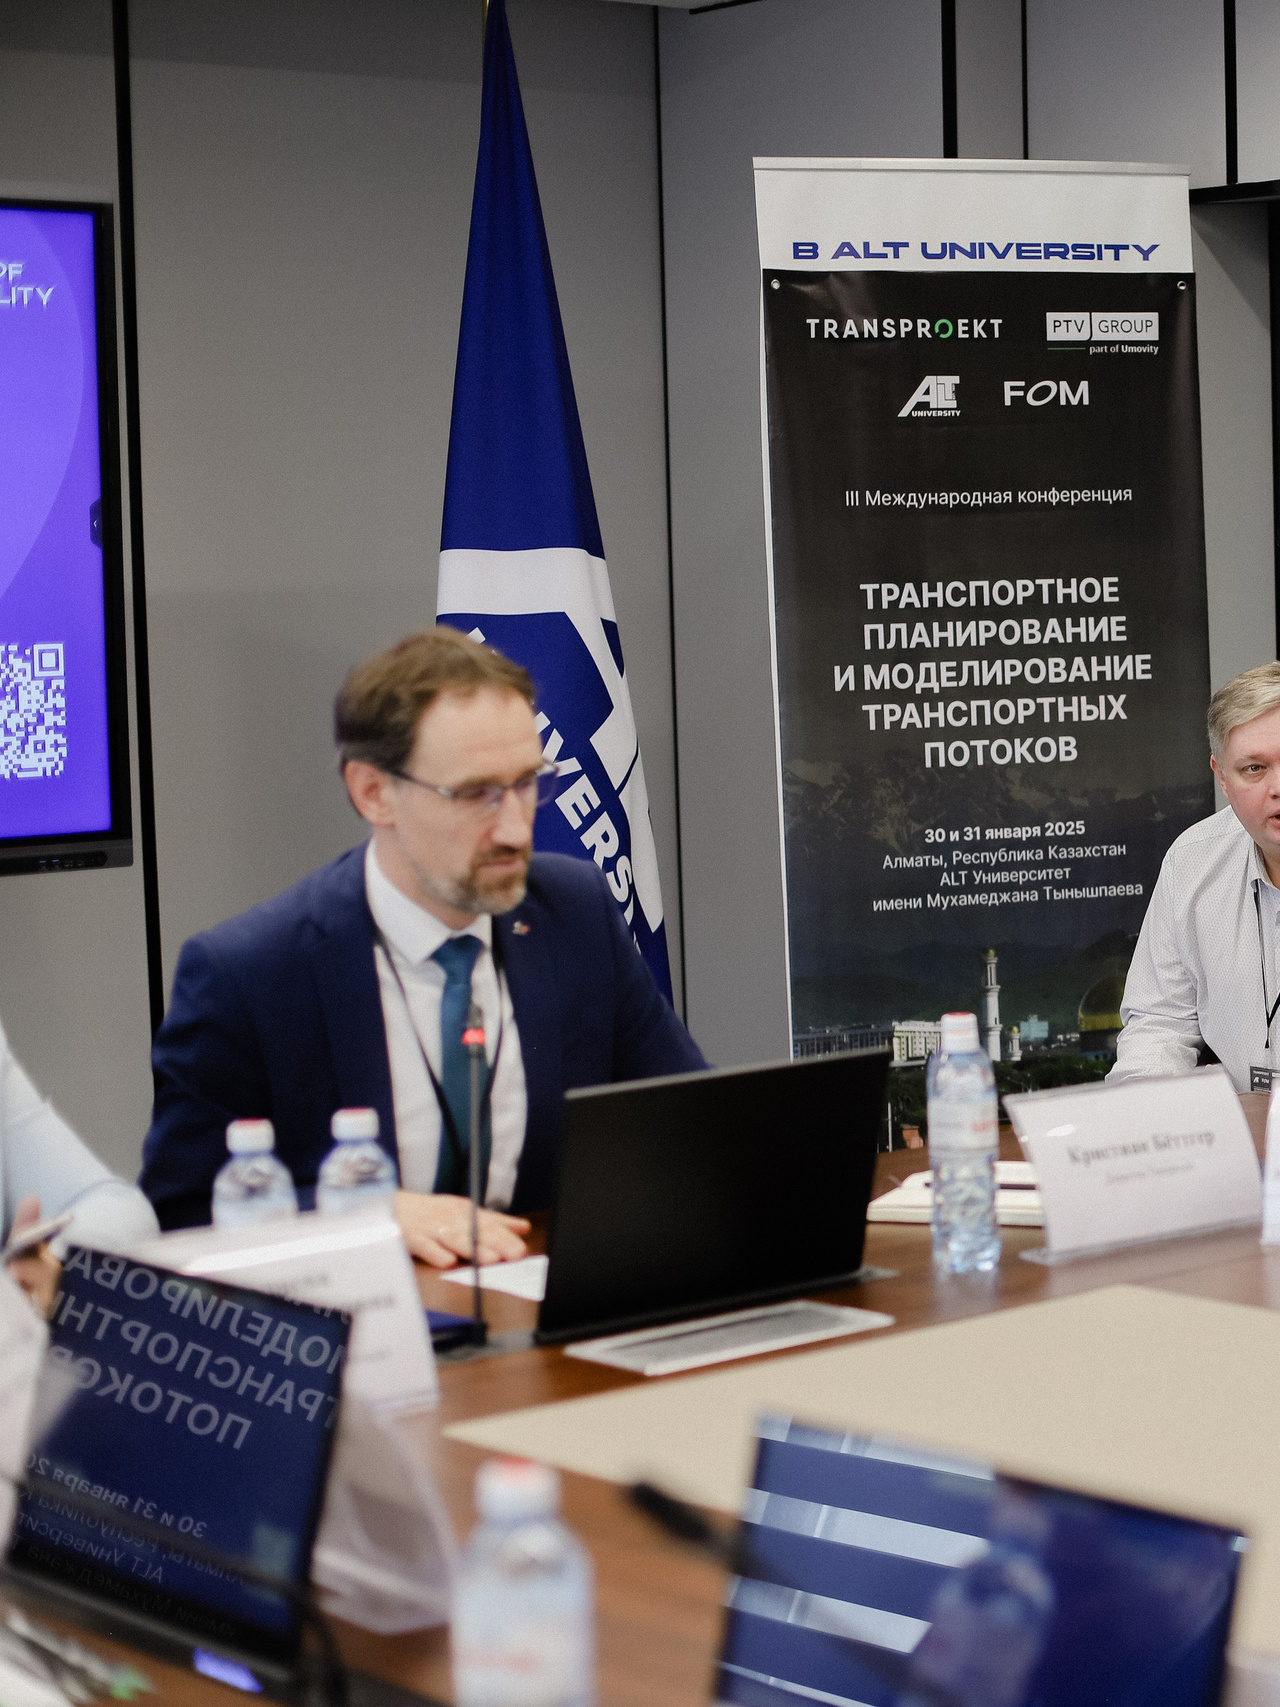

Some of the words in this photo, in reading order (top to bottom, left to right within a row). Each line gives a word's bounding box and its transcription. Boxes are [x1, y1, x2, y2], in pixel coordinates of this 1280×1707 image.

[792, 241, 819, 260] B
[830, 241, 910, 260] ALT
[920, 241, 1160, 262] UNIVERSITY
[806, 318, 1003, 339] TRANSPROEKT
[1053, 319, 1085, 333] PTV
[1098, 319, 1154, 334] GROUP
[1089, 345, 1108, 355] part
[1109, 344, 1119, 353] of
[1121, 344, 1159, 355] Umovity
[1003, 380, 1090, 407] FOM
[911, 409, 961, 417] UNIVERSITY
[845, 490, 859, 507] III
[865, 489, 1012, 509] Международная
[1018, 486, 1132, 506] конференция
[859, 576, 1120, 610] ТРАНСПОРТНОЕ
[863, 615, 1128, 650] ПЛАНИРОВАНИЕ
[833, 664, 855, 692] И
[863, 654, 1153, 695] МОДЕЛИРОВАНИЕ
[861, 694, 1128, 731] ТРАНСПОРТНЫХ
[924, 735, 1078, 768] ПОТОКОВ
[924, 827, 946, 843] 30
[949, 830, 960, 842] и
[963, 826, 981, 841] 31
[984, 825, 1041, 842] января
[1044, 820, 1086, 837] 2025
[882, 854, 948, 870] Алматы,
[952, 847, 1044, 867] Республика
[1048, 844, 1126, 860] Казахстан
[939, 870, 968, 887] ALT
[972, 867, 1071, 885] Университет
[873, 897, 923, 912] имени
[927, 890, 1039, 911] Мухамеджана
[1043, 883, 1143, 901] Тынышпаева
